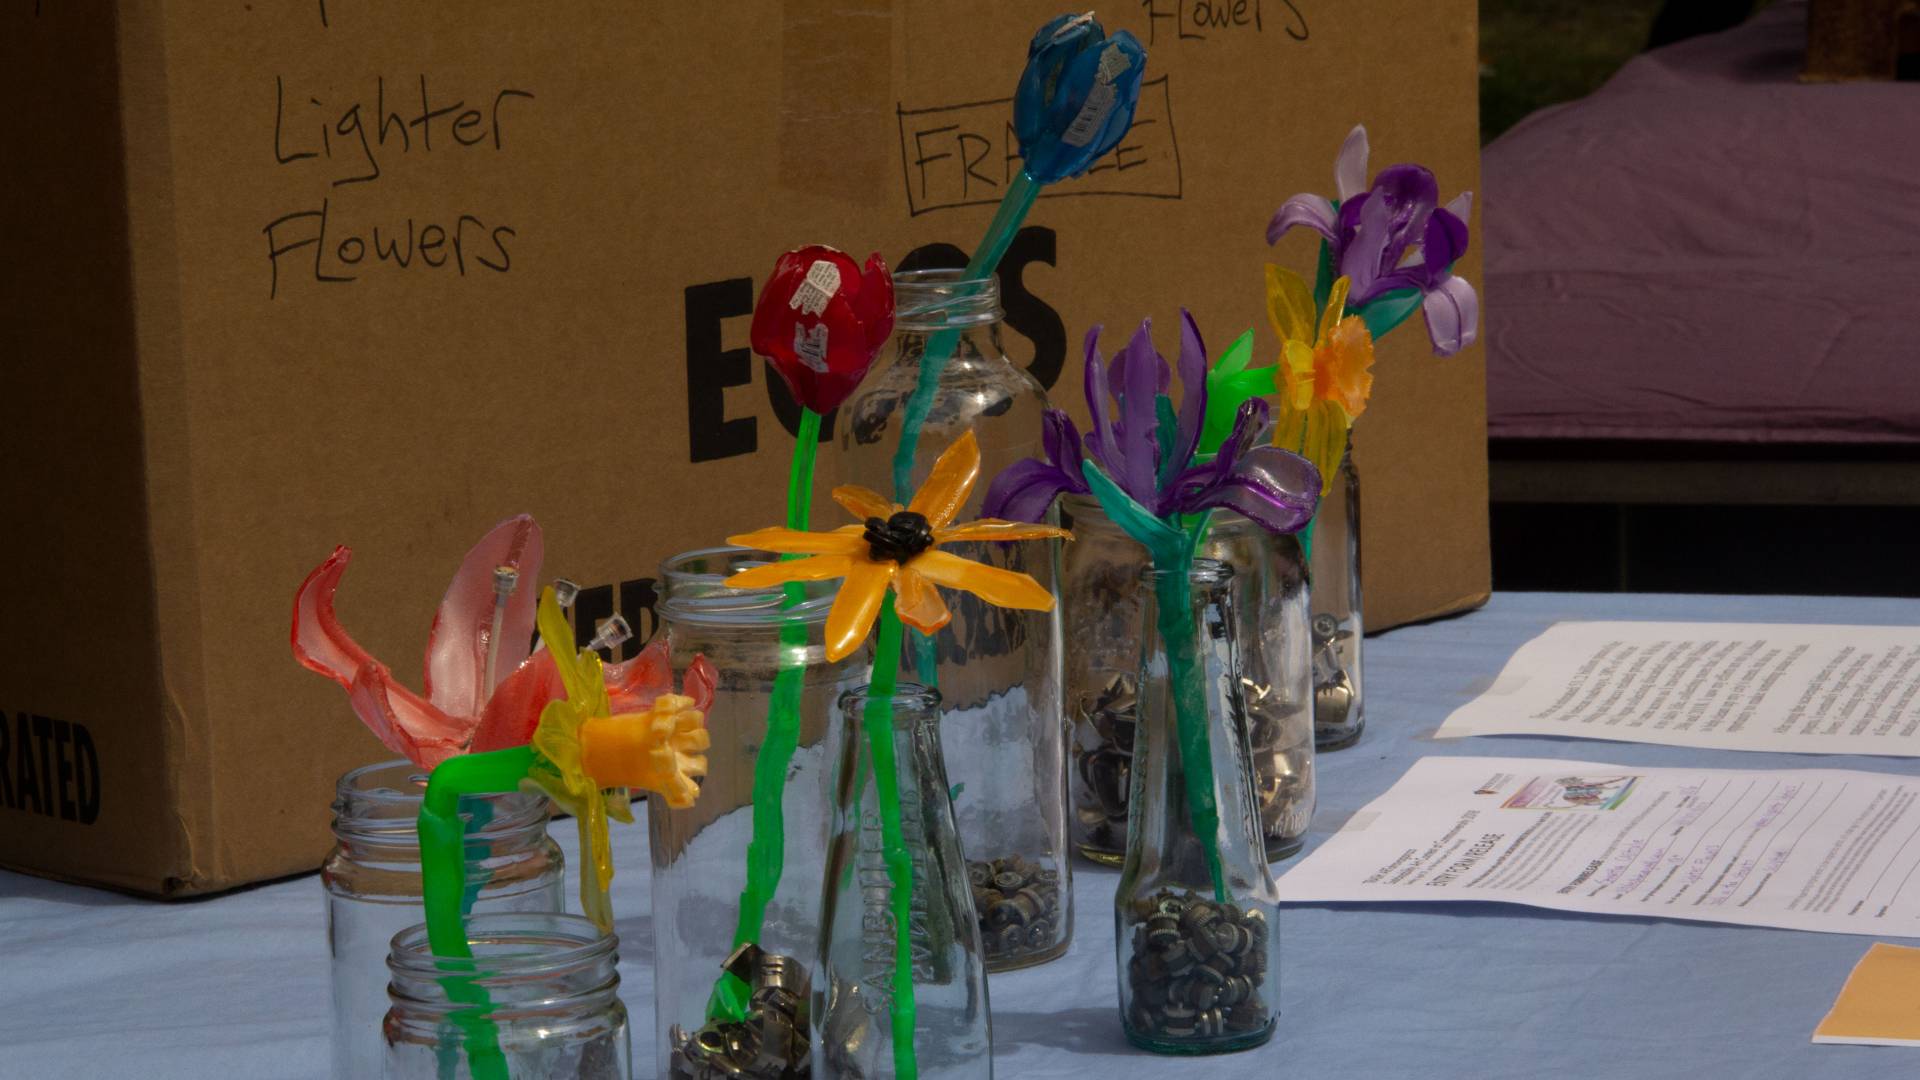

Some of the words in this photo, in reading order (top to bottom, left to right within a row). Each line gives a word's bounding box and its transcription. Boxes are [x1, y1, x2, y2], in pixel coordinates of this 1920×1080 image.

[273, 75, 535, 188] Lighter
[915, 119, 1157, 200] FRAE
[685, 226, 1066, 463] ES
